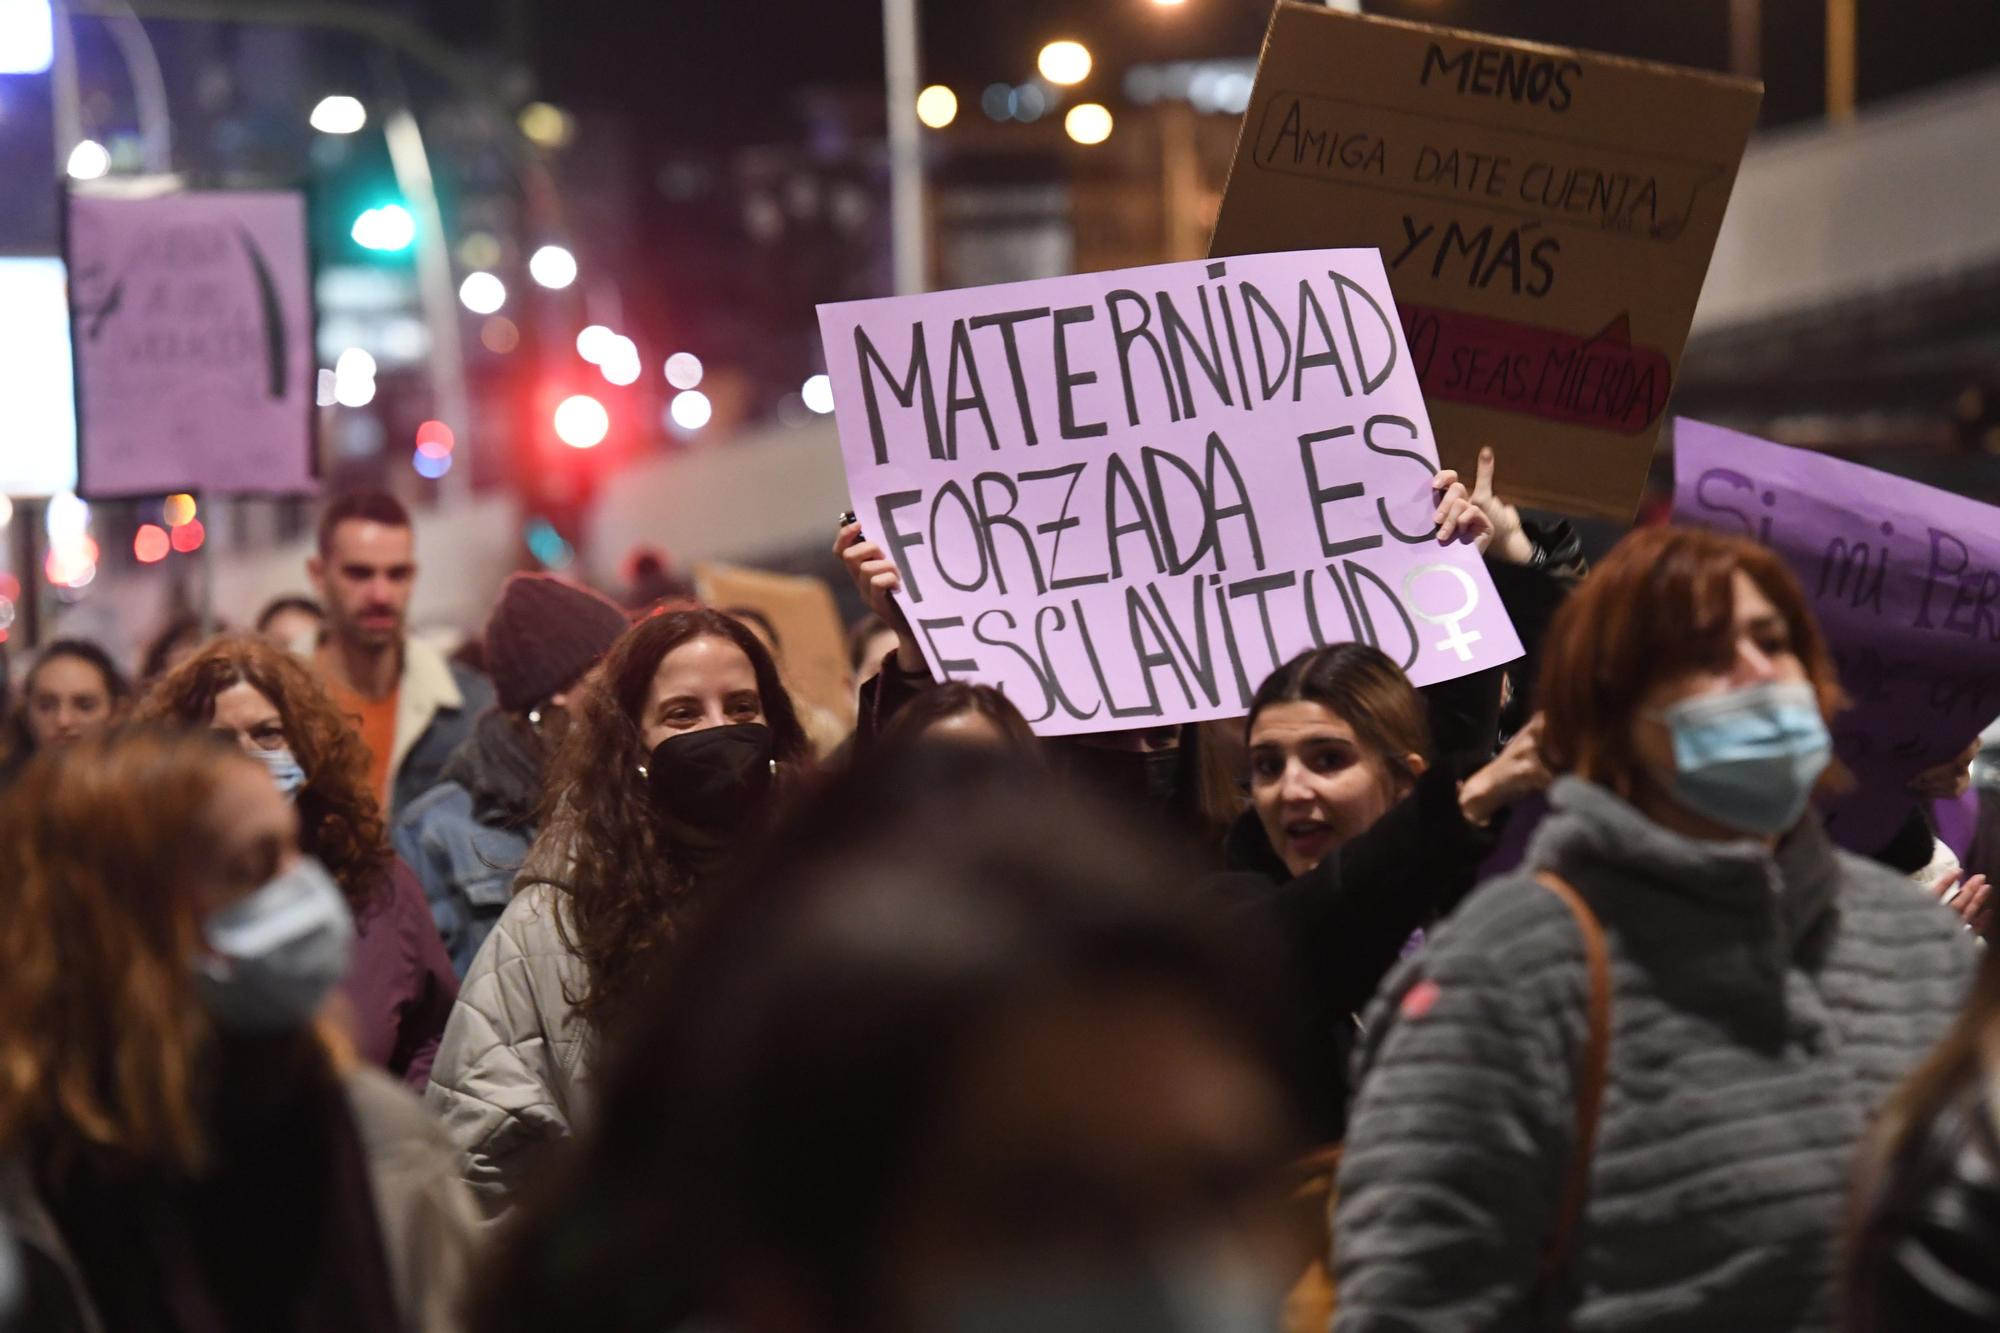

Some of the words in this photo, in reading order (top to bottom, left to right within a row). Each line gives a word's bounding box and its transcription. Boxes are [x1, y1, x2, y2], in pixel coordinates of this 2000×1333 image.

[1419, 42, 1583, 112] MENOS
[1266, 100, 1385, 176] AMIGA
[1413, 145, 1511, 198] DATE
[1520, 162, 1657, 219] CUENTA
[1444, 345, 1532, 402] SEAS
[1532, 345, 1656, 426] MIERDA
[875, 431, 1266, 602] FORZADA
[1297, 414, 1438, 558] ES
